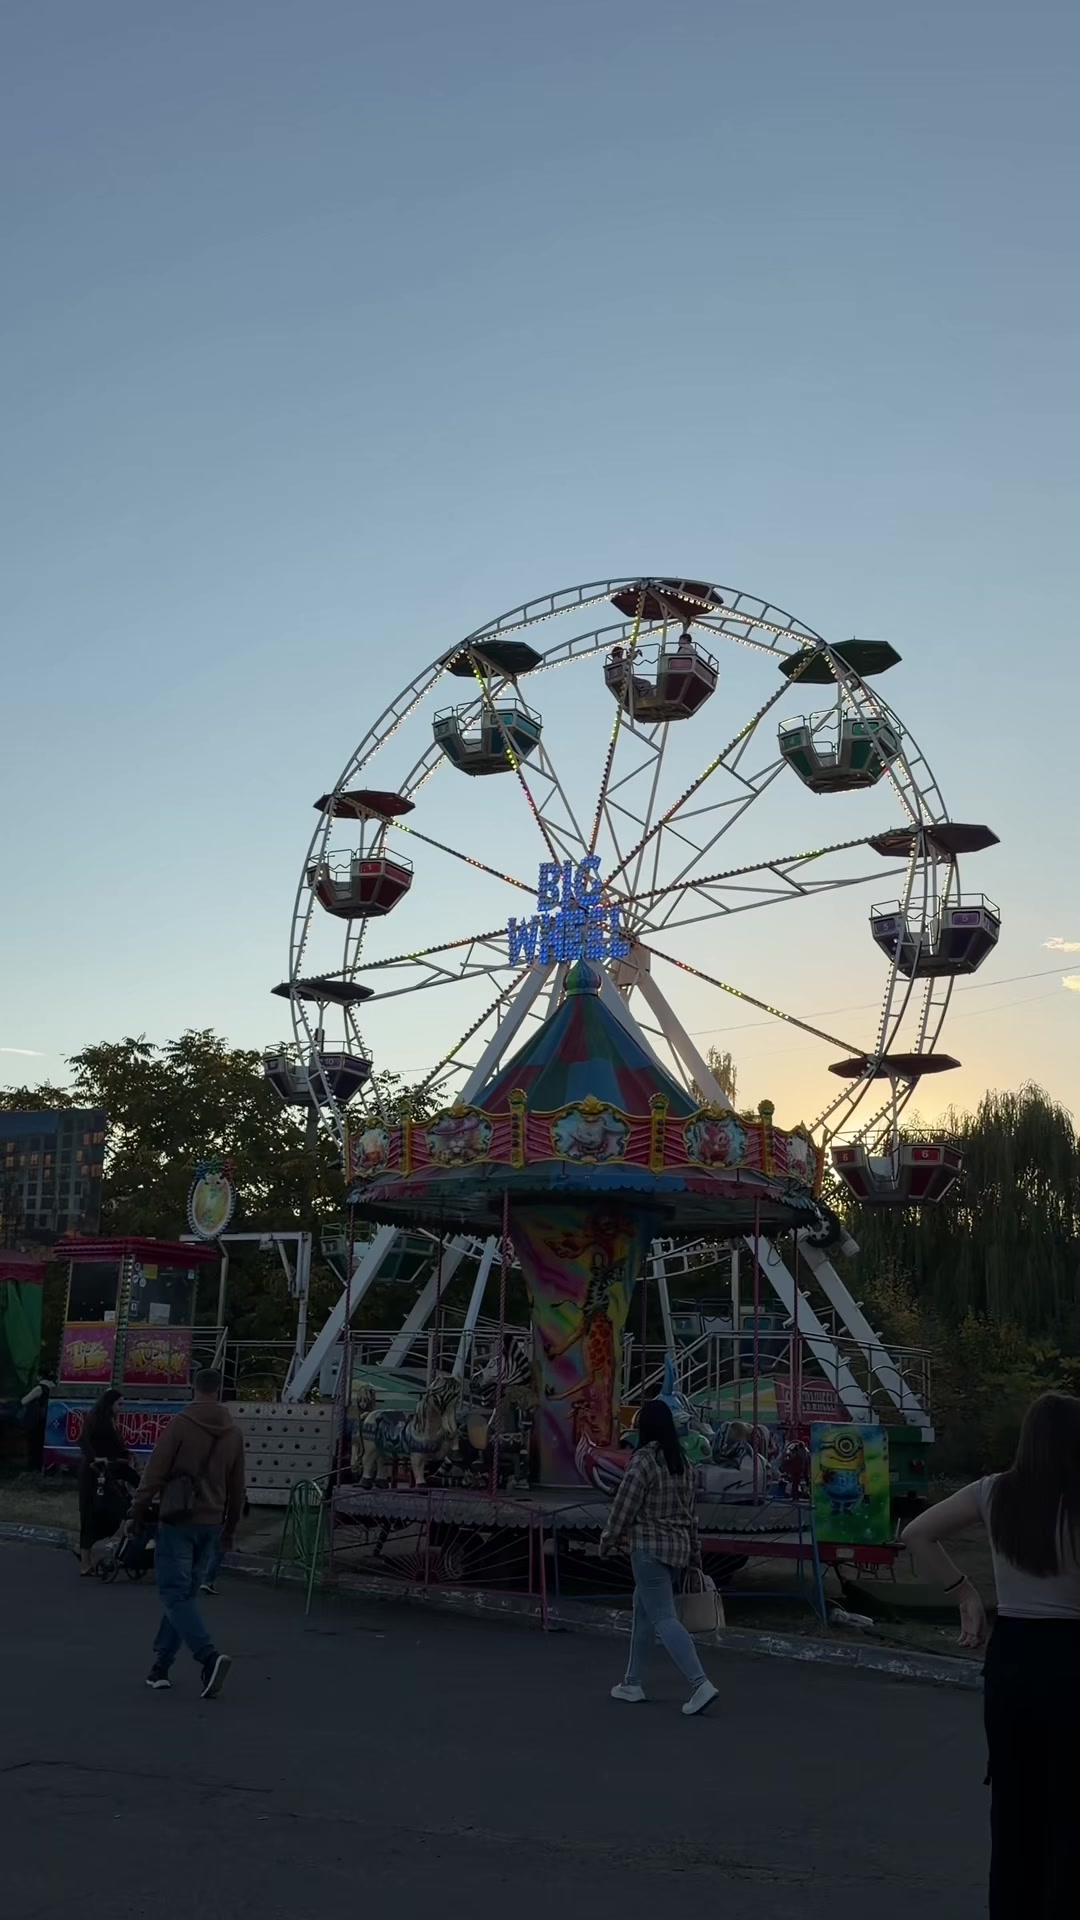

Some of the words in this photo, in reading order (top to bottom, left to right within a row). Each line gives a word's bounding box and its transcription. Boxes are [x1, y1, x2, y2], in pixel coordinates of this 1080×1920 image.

[538, 855, 601, 912] BIG
[508, 904, 629, 967] WHEEL
[842, 1153, 849, 1162] 6
[921, 1150, 929, 1158] 6
